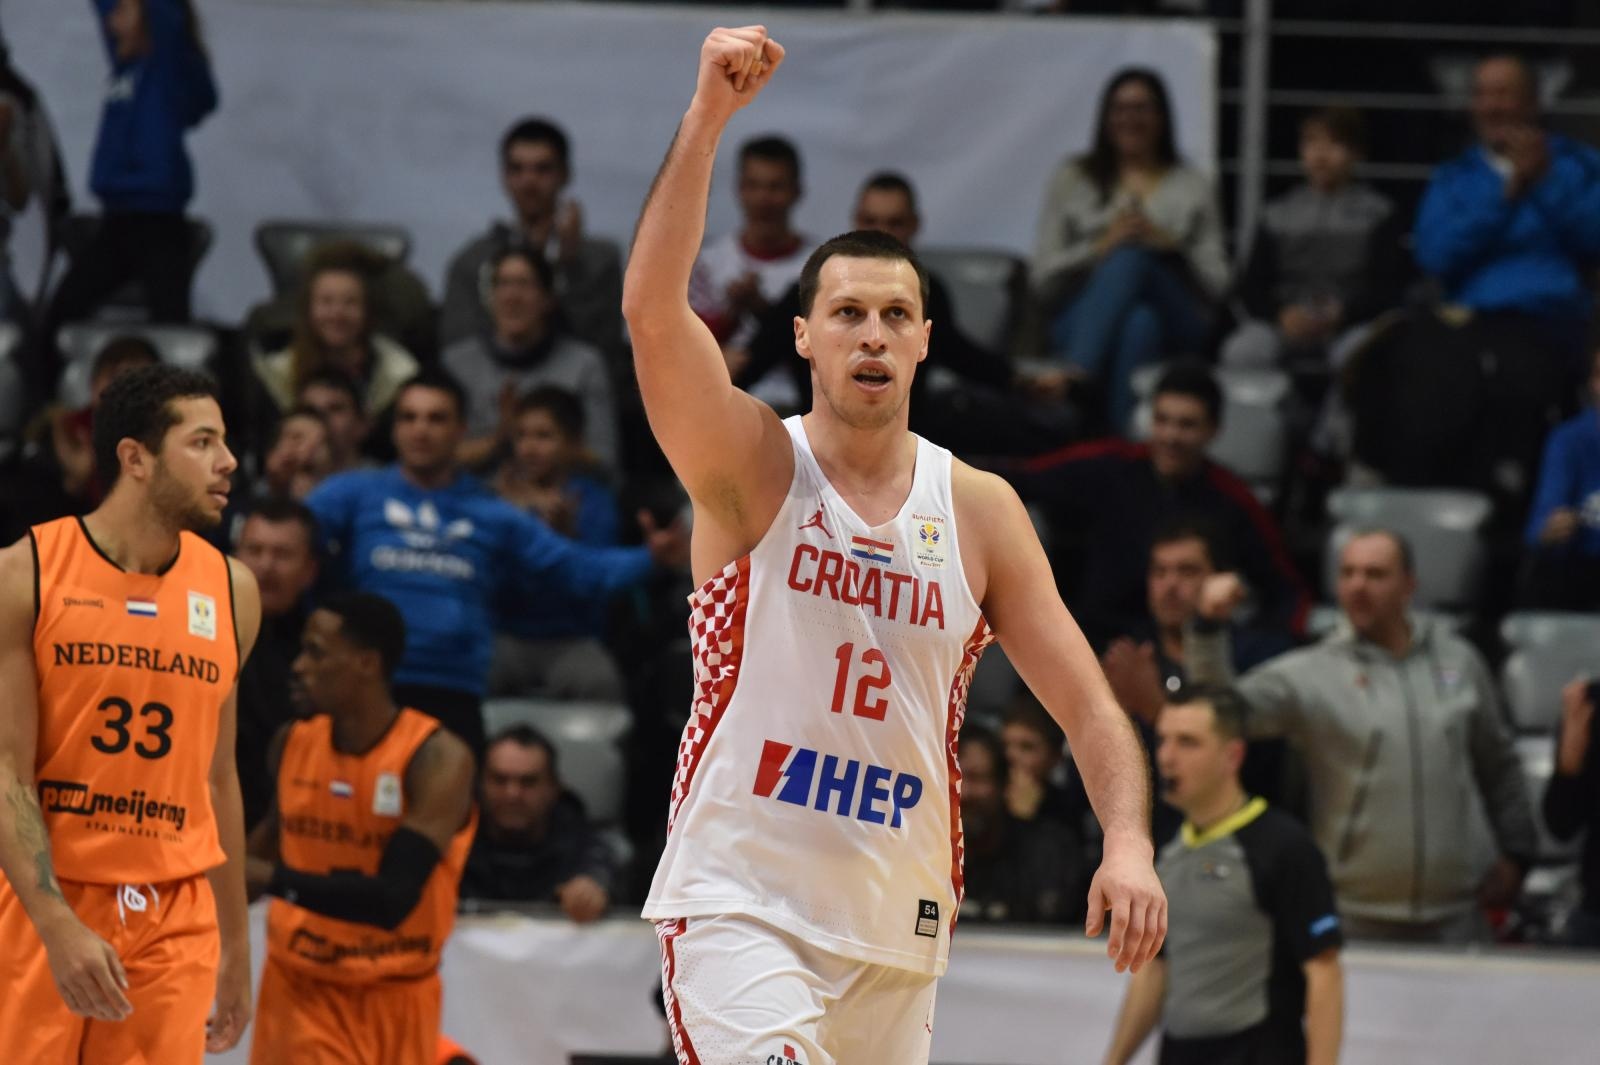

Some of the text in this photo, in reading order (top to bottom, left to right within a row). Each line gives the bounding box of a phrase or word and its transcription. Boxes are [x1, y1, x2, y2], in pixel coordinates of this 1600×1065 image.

[788, 544, 945, 630] CROATIA
[53, 643, 220, 684] NEDERLAND
[831, 642, 892, 721] 12
[91, 696, 174, 760] 33
[814, 754, 923, 829] HEP
[924, 904, 936, 916] 54
